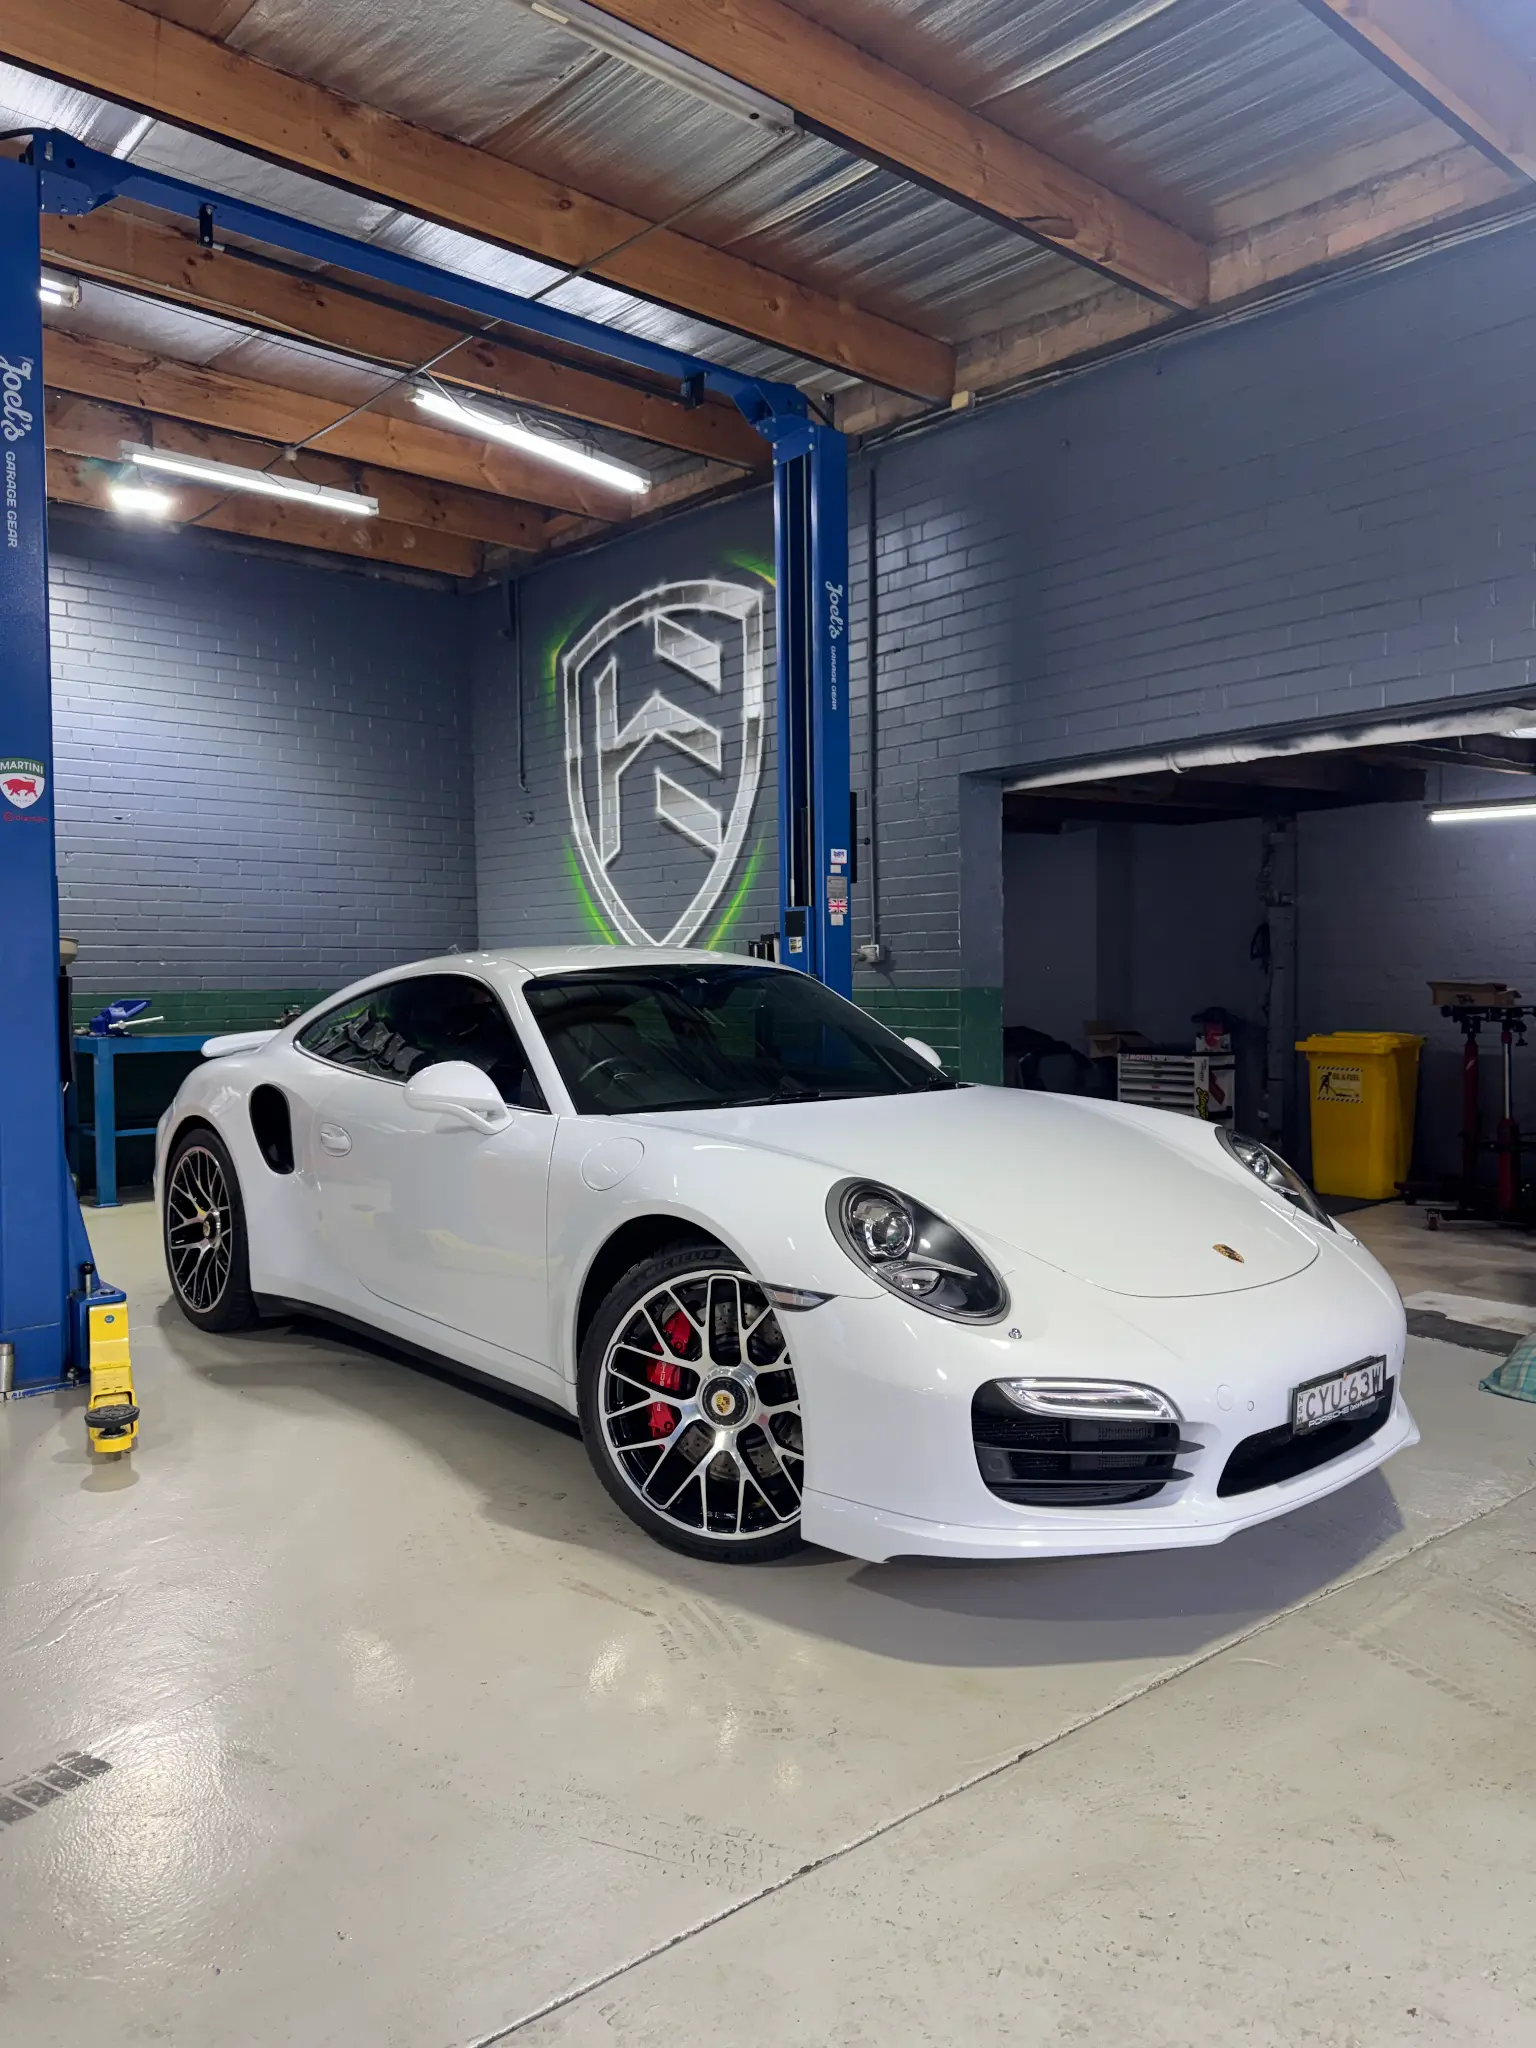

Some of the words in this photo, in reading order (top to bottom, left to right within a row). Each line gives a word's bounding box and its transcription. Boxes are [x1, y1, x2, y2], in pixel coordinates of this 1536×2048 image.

[0, 355, 34, 442] Joel's
[5, 450, 17, 508] GARAGE
[7, 510, 18, 548] GEAR
[825, 580, 844, 640] Joel's
[0, 760, 44, 774] MARTINI
[1308, 1406, 1350, 1428] PORSCHE
